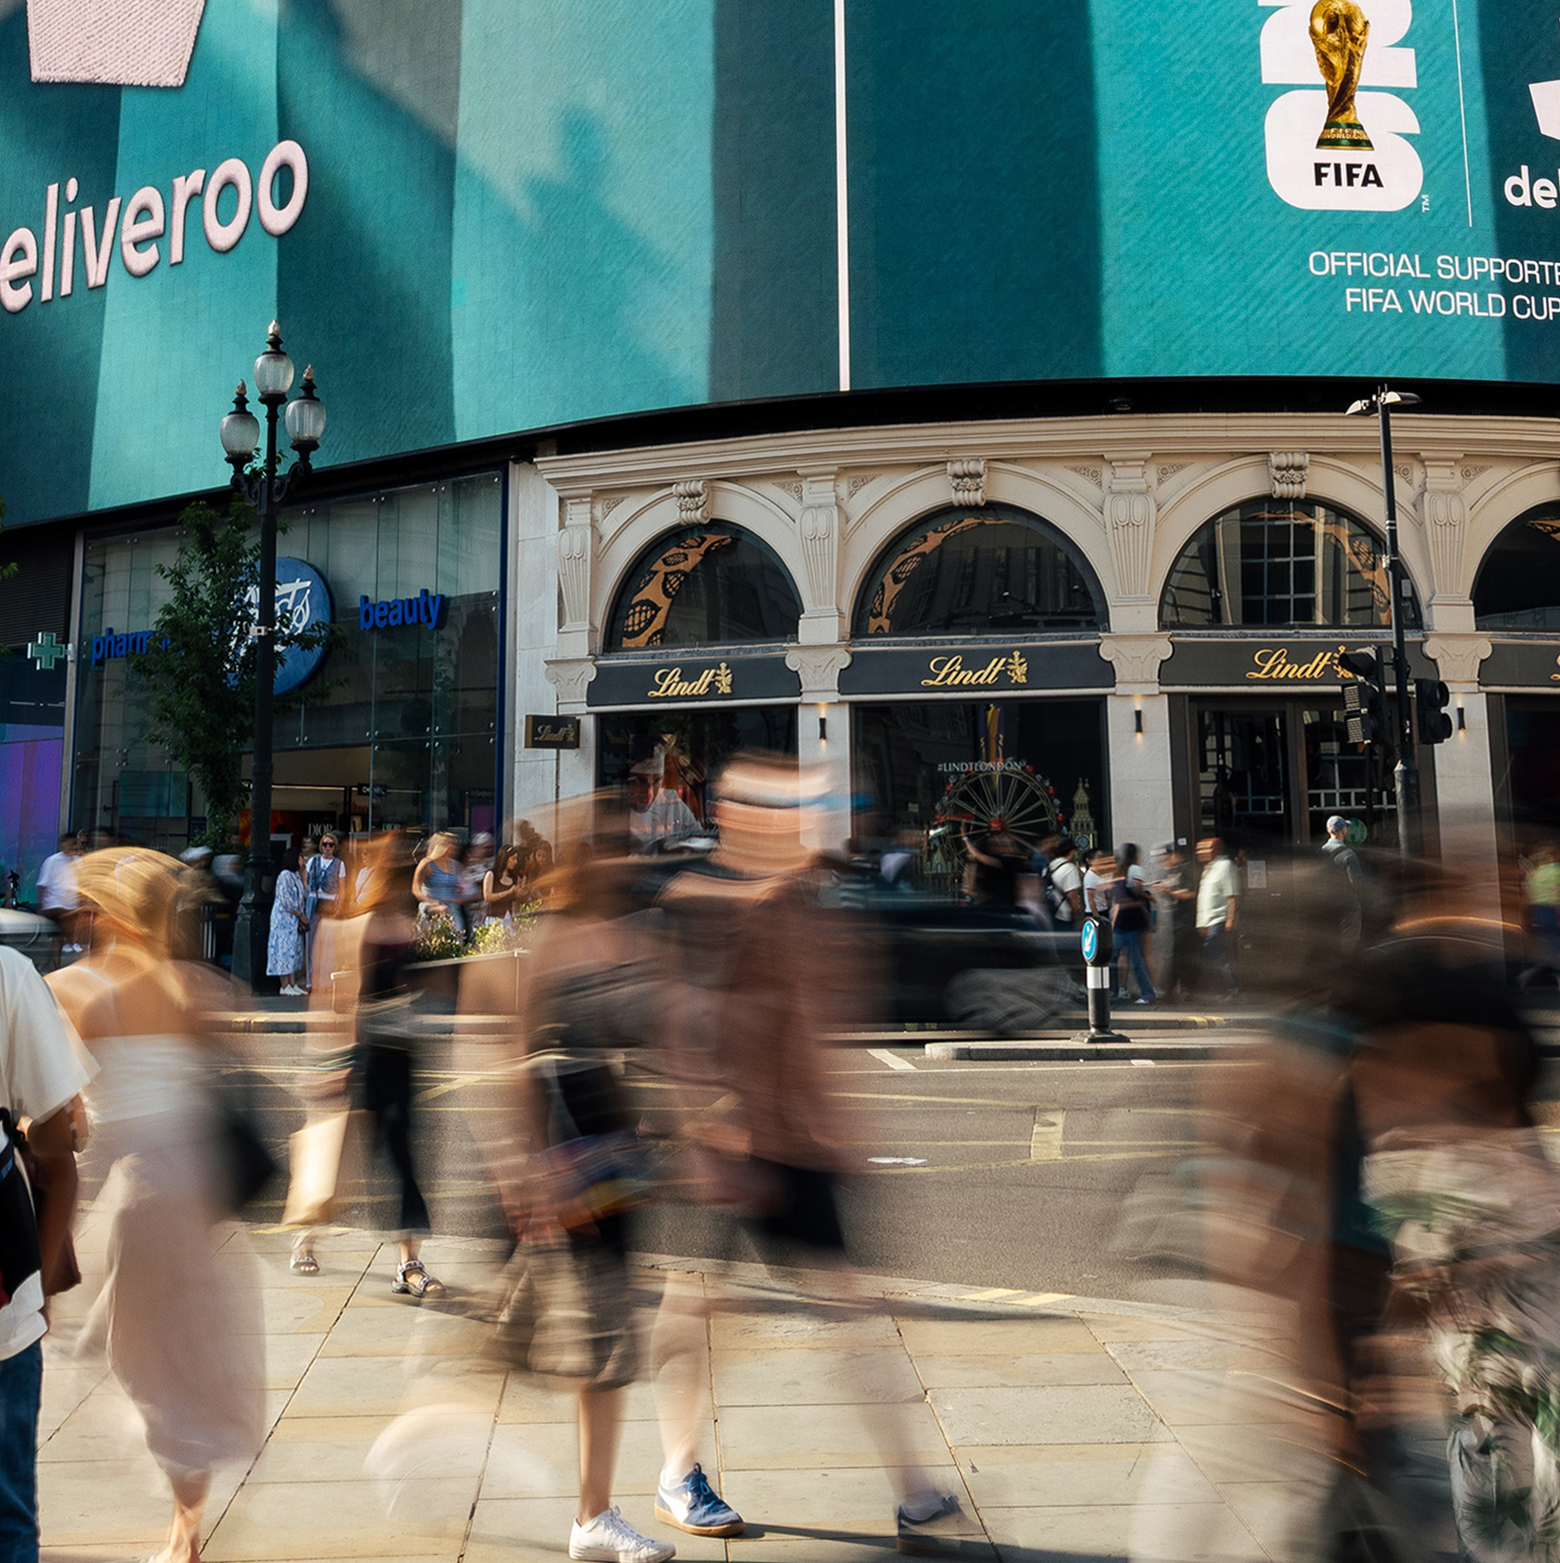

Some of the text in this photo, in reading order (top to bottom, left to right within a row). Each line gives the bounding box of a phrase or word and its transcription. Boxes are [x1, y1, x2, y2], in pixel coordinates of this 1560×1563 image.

[1313, 162, 1384, 188] FIFA
[1309, 251, 1431, 278] OFFICIAL
[1345, 288, 1402, 313] FIFA
[1408, 290, 1505, 317] WORLD
[359, 588, 445, 630] beauty
[921, 655, 1007, 686] Lindt
[1245, 648, 1333, 679] Lindt
[647, 667, 716, 697] Lindt
[534, 724, 568, 741] Lindt
[937, 760, 1022, 773] #LINDTLONDON
[308, 823, 333, 836] DIOR
